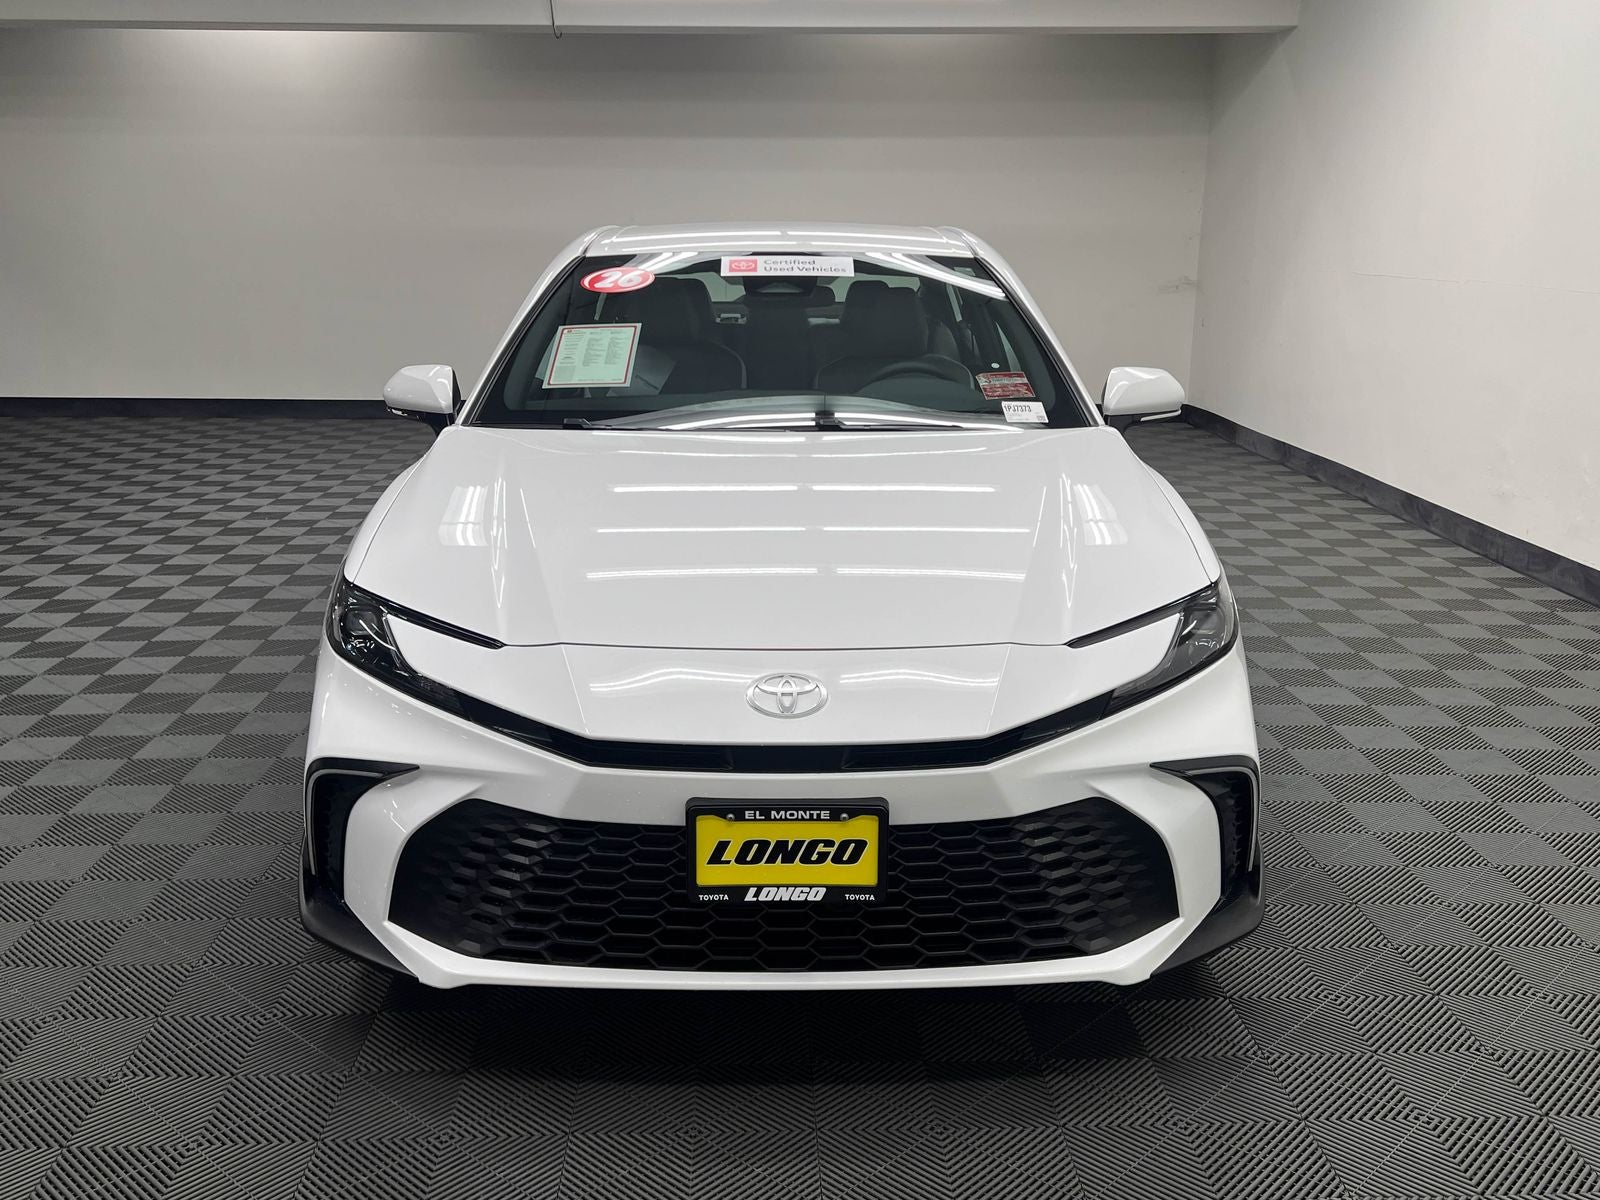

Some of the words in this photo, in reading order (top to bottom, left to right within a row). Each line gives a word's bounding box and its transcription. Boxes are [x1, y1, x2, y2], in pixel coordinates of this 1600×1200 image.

[594, 270, 645, 288] 26
[744, 810, 765, 820] EL
[770, 810, 831, 820] MONTE
[706, 838, 869, 866] LONGO
[744, 887, 827, 902] LONGO
[844, 893, 875, 901] TOYOTA
